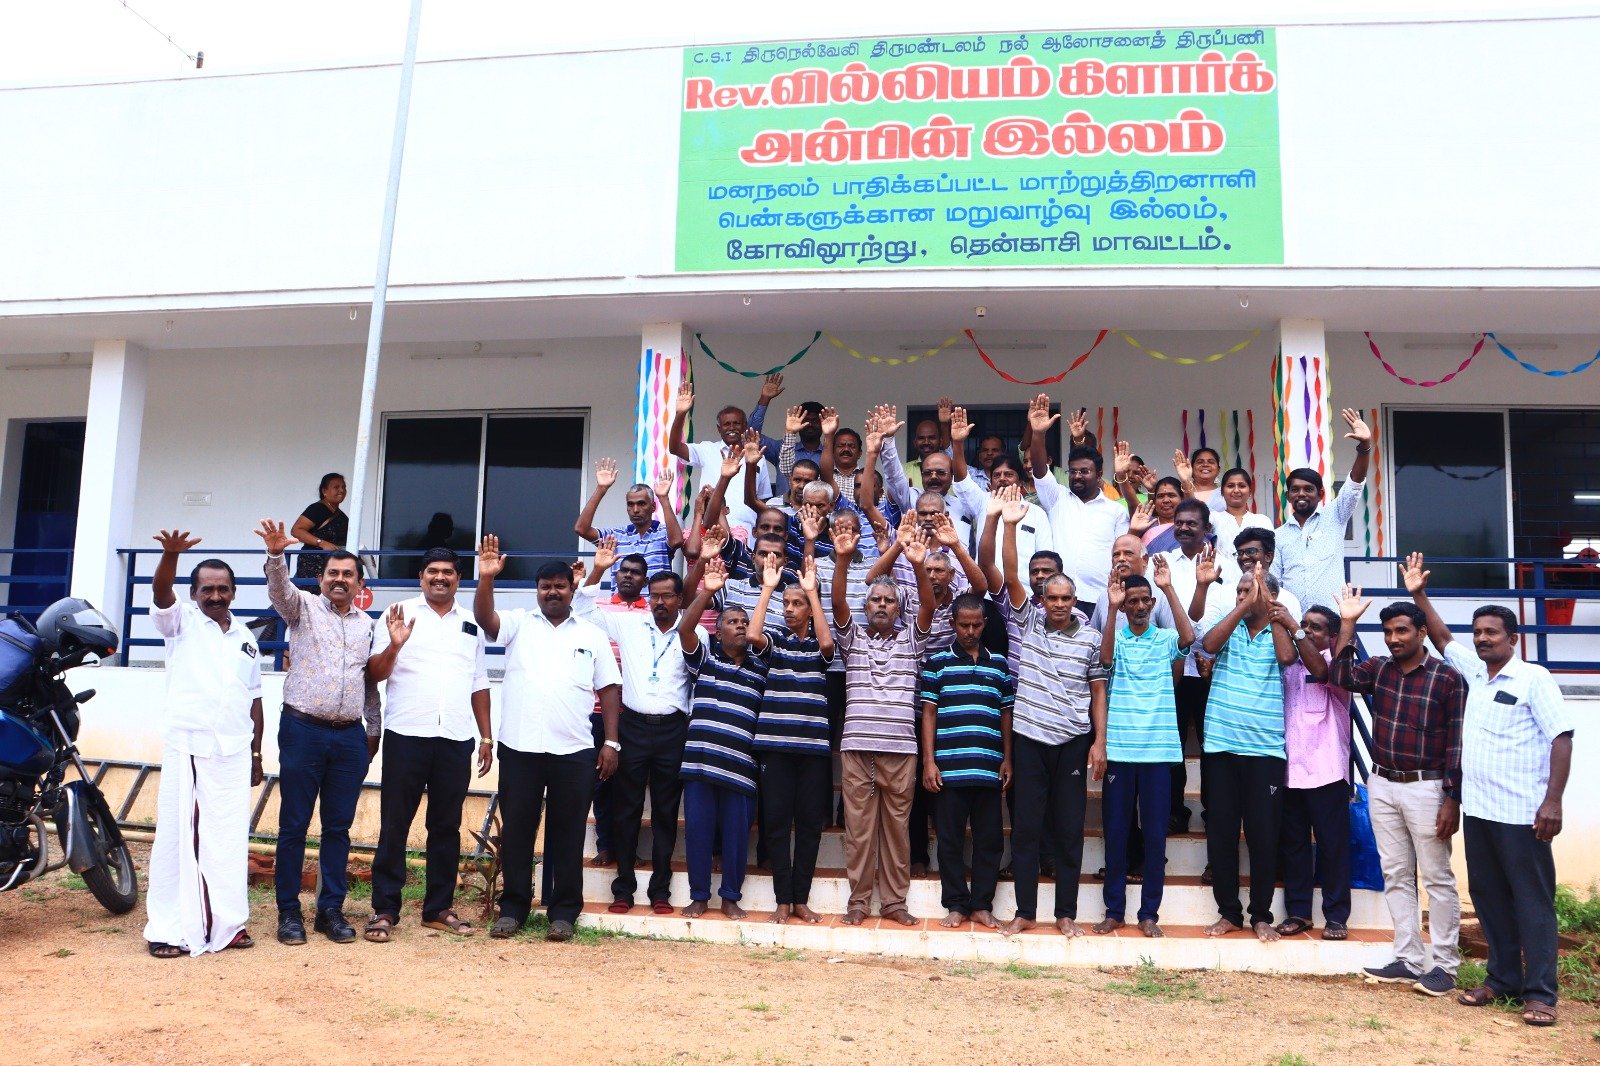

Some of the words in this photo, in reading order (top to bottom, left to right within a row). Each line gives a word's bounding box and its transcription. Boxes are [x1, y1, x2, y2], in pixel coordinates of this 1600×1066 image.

[693, 51, 732, 64] C.S.I
[741, 42, 860, 64] திருநெல்வேலி
[869, 36, 986, 59] திருமண்டலம்
[998, 33, 1029, 54] நல்
[1041, 30, 1167, 53] ஆலோசனைத்
[1175, 29, 1265, 50] திருப்பணி
[1058, 52, 1275, 96] கிளார்க்
[740, 116, 974, 165] அன்பின்
[982, 110, 1224, 157] இல்லம்
[708, 176, 820, 204] மனநலம்
[833, 173, 1009, 200] பாதிக்கப்பட்ட
[1019, 169, 1256, 198] மாற்றுத்திறனாளி
[718, 203, 936, 231] பெண்களுக்கான
[946, 197, 1091, 229] மறுவாழ்வு
[1109, 195, 1228, 222] இல்லம்,
[726, 233, 928, 265] கோவிலூற்று,
[950, 231, 1081, 260] தென்காசி
[1092, 225, 1232, 253] மாவட்டம்.
